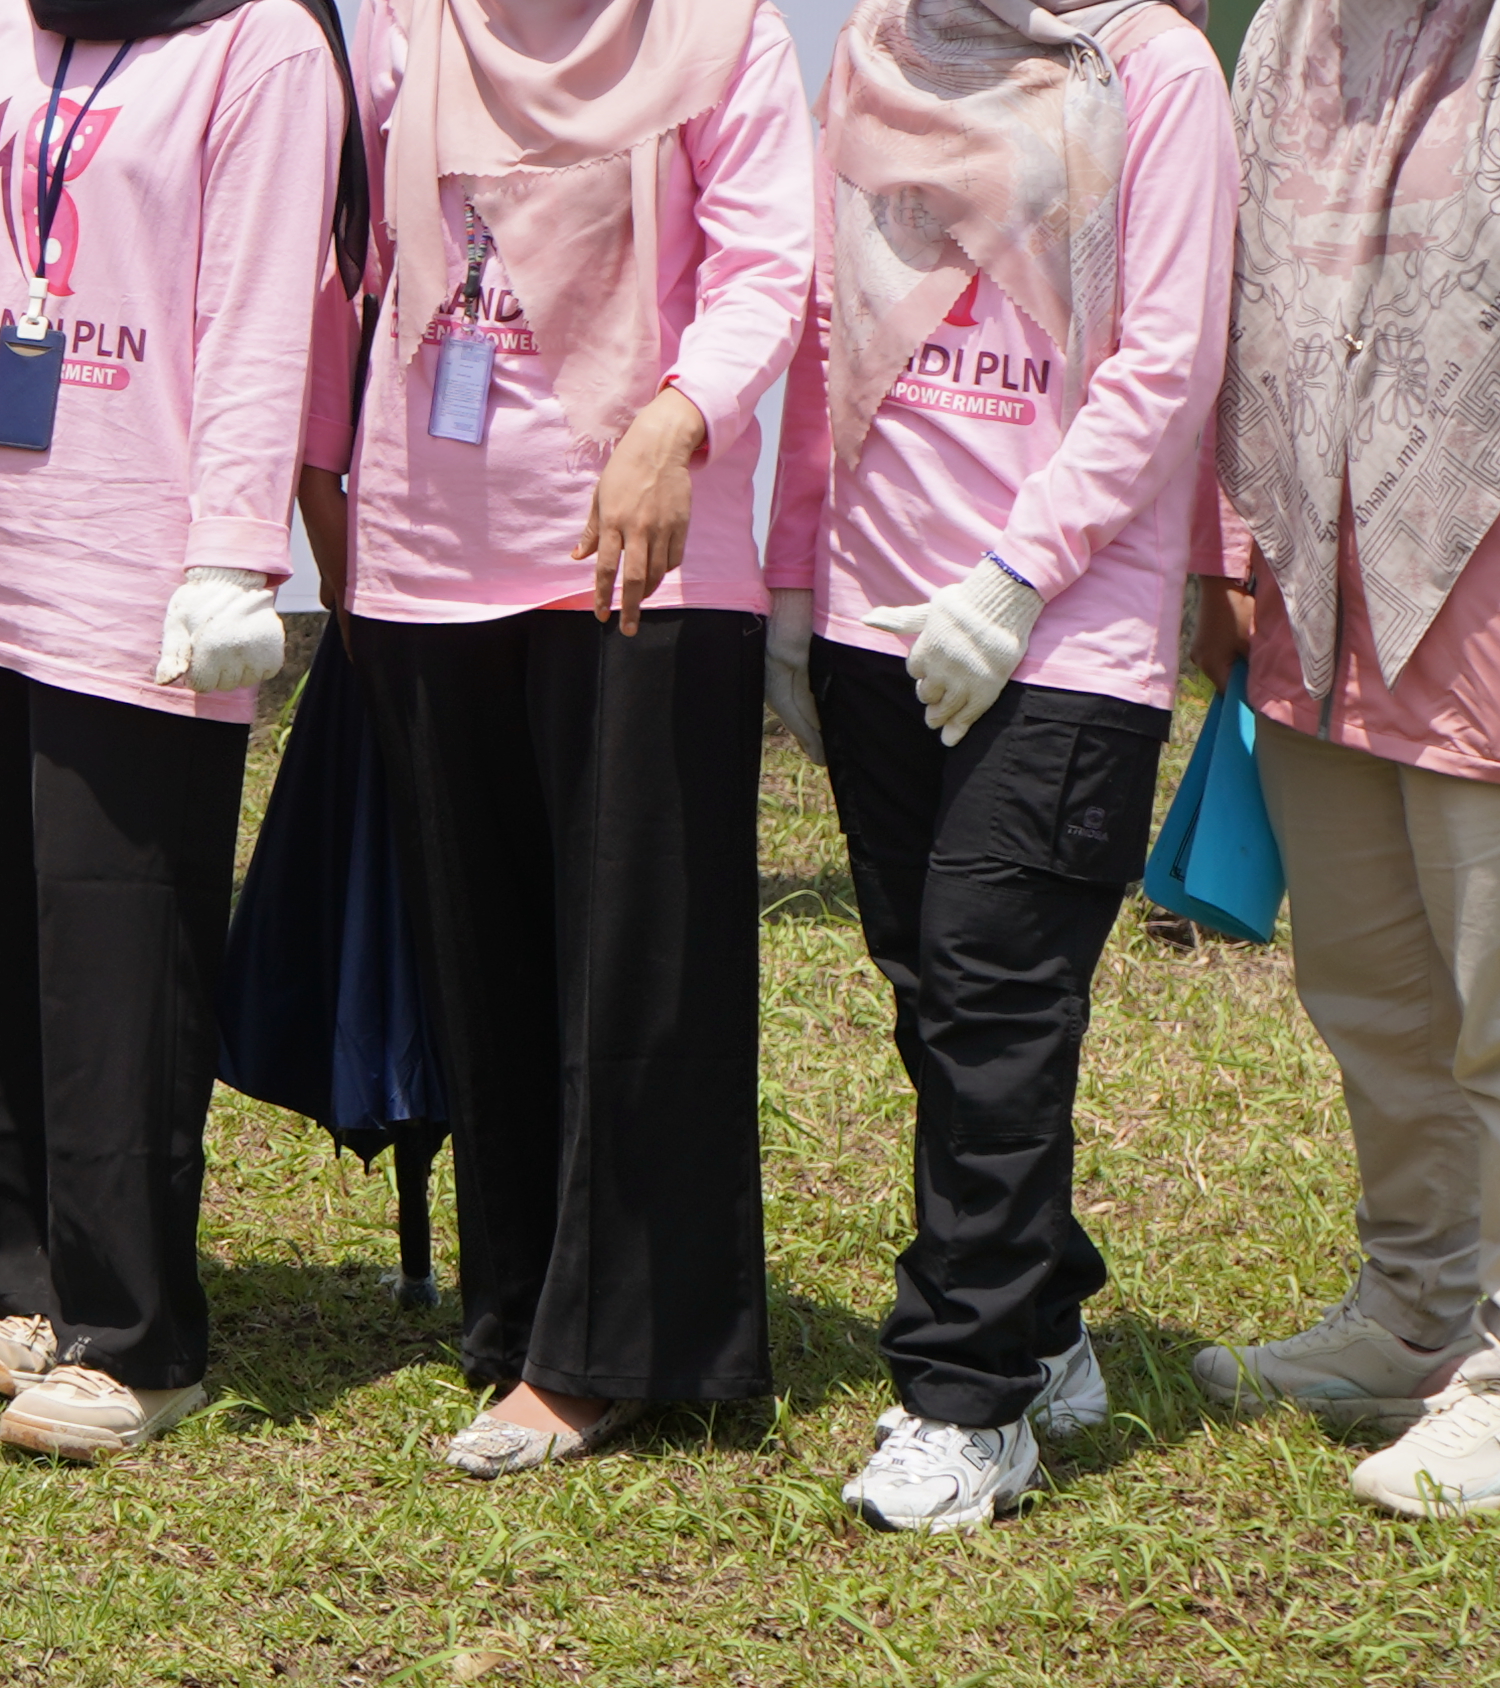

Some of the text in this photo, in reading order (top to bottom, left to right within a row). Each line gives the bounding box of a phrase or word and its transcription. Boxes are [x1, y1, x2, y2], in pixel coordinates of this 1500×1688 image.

[72, 320, 147, 362] PLN
[974, 351, 1050, 394] PLN
[889, 382, 1025, 421] POWERMENT
